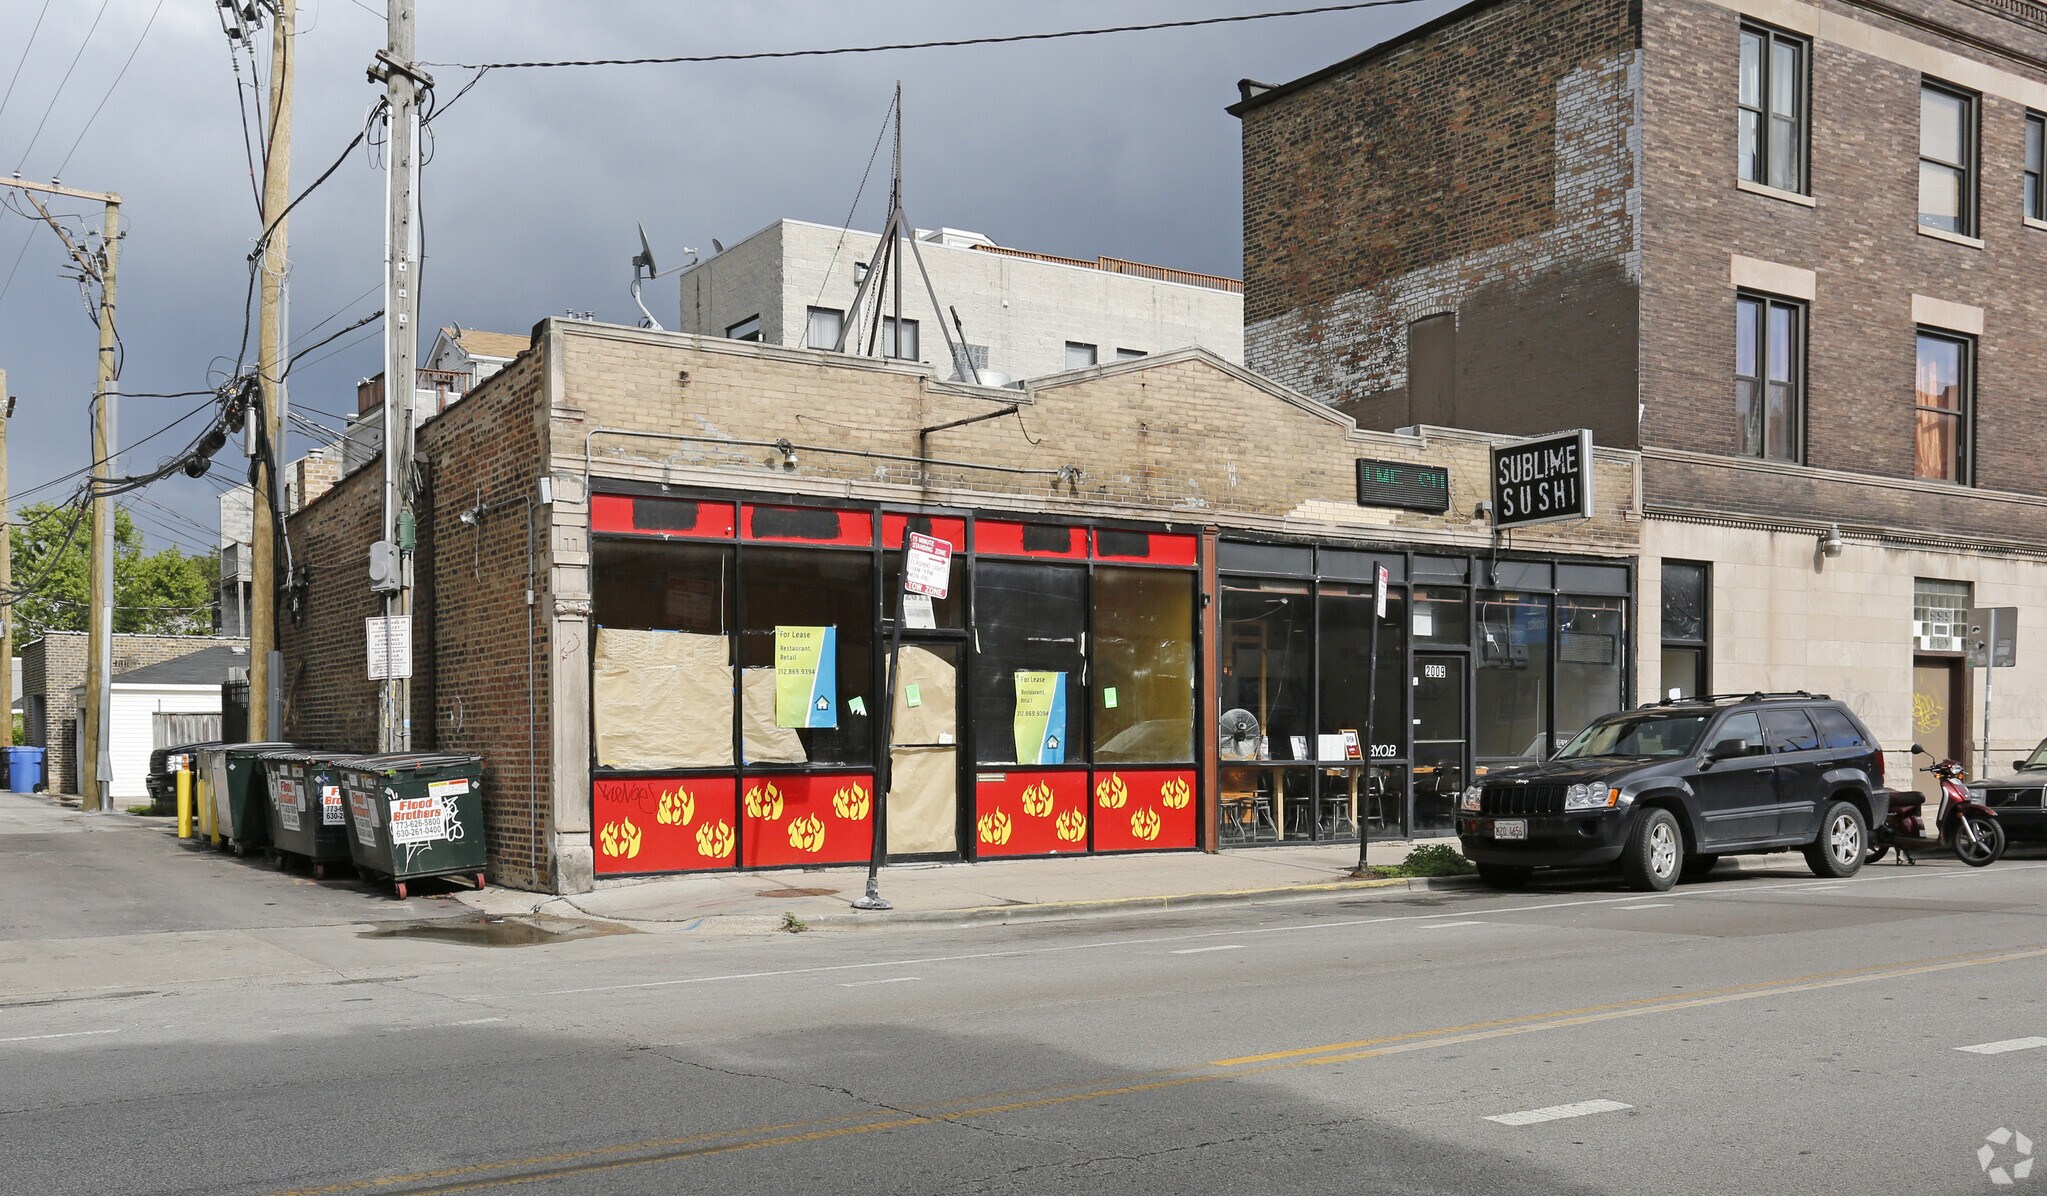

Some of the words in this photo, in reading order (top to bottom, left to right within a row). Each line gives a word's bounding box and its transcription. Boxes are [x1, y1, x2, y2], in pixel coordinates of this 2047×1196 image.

[1499, 445, 1578, 485] SUBLIME
[1503, 478, 1575, 516] SUSHI
[912, 542, 934, 553] STANDING
[935, 548, 947, 556] ZONE
[919, 537, 935, 547] MINUTE
[910, 558, 930, 569] FLASHING
[932, 564, 946, 573] LIGHTS
[908, 581, 922, 592] TOW
[924, 586, 943, 597] ZONE
[1426, 666, 1445, 677] 2009
[399, 798, 432, 811] Flood
[393, 808, 441, 822] Brothers
[396, 818, 440, 829] 773-626-5800
[396, 826, 441, 837] 630-261-0400
